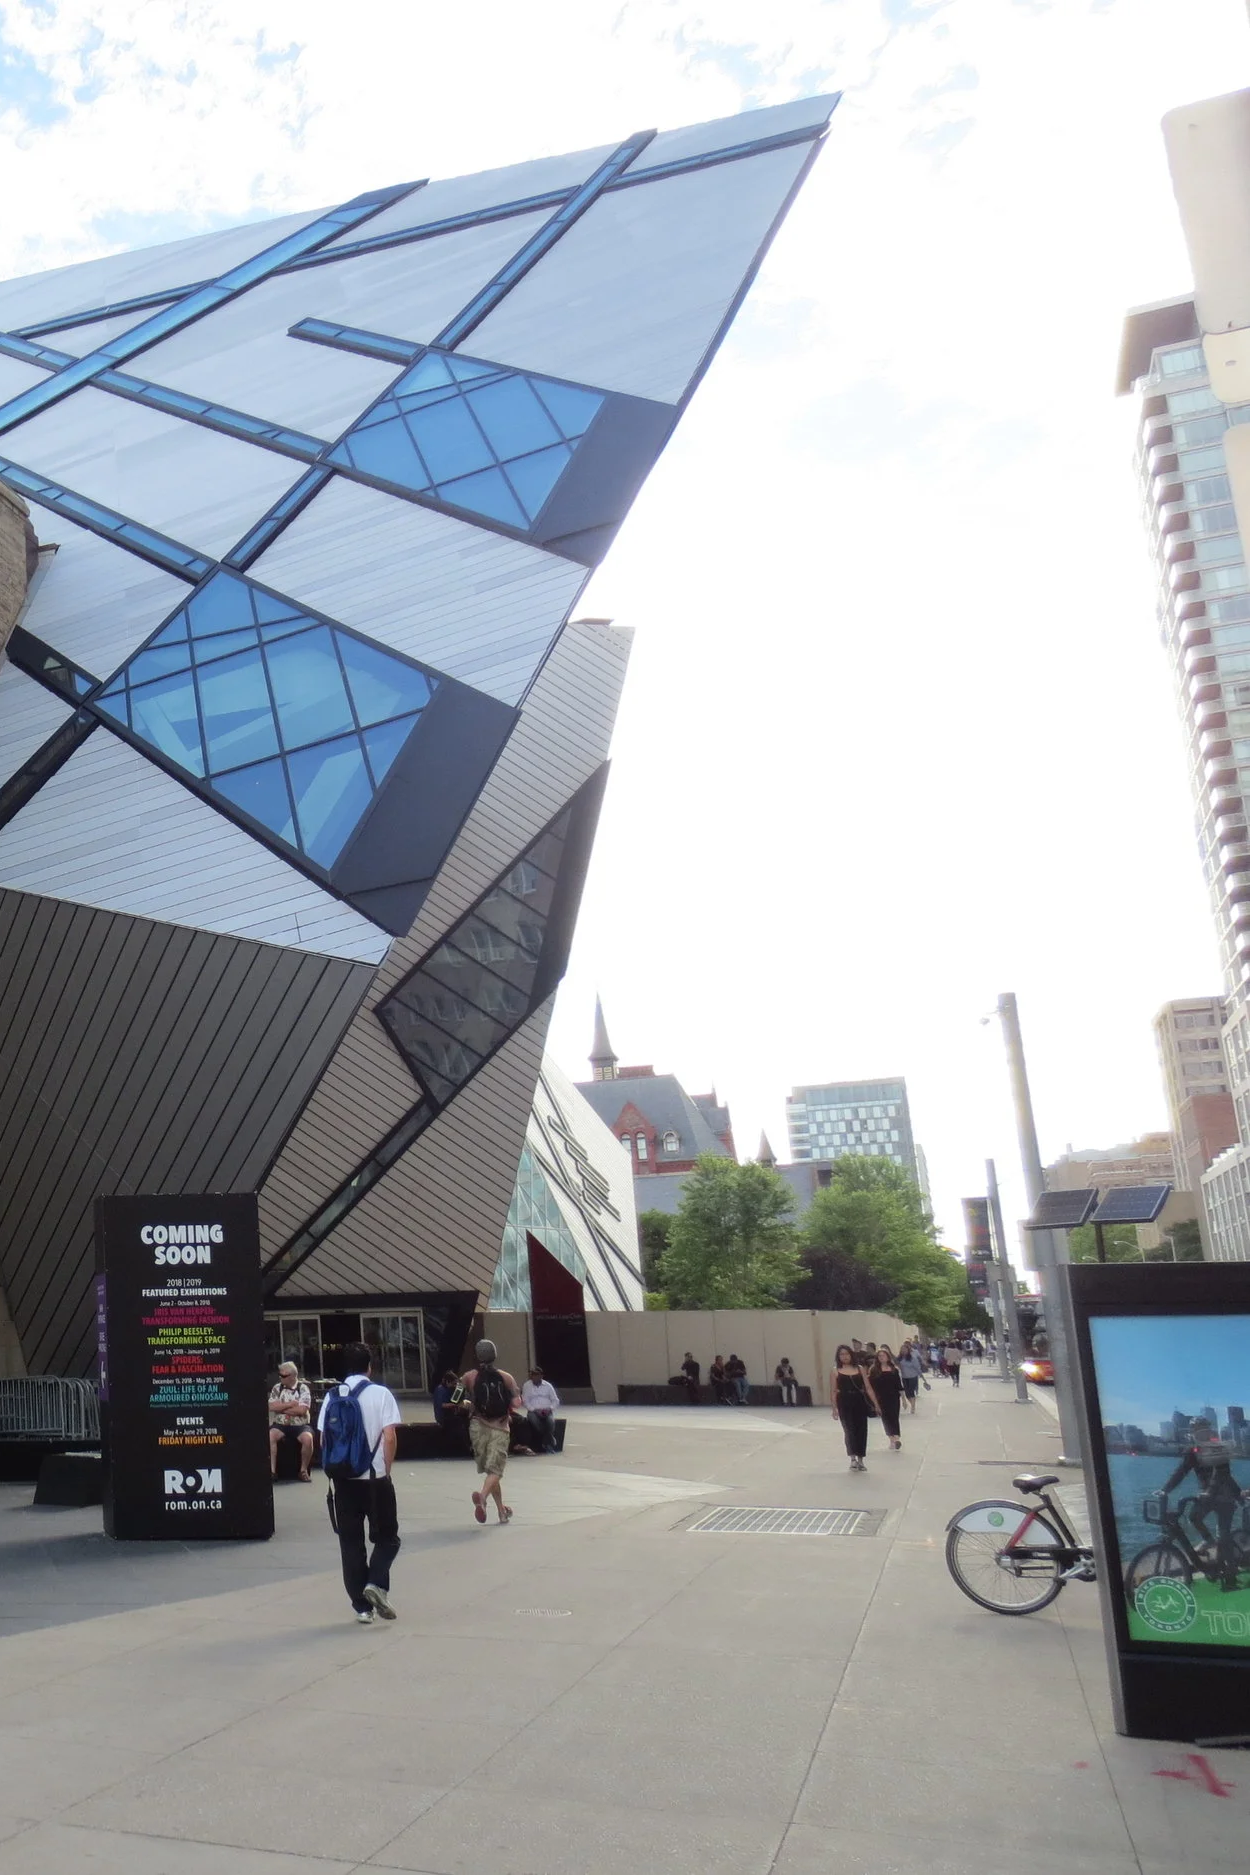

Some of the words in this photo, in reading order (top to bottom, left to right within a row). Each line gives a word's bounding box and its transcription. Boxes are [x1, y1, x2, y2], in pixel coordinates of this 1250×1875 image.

[140, 1224, 224, 1245] COMING
[154, 1246, 211, 1265] SOON
[142, 1288, 179, 1297] FEATURED
[180, 1287, 228, 1296] EXHIBITIONS
[142, 1316, 198, 1325] TRANSFORMING
[199, 1315, 229, 1324] FASHION
[158, 1328, 182, 1336] PHILIP
[183, 1327, 214, 1335] BEESLEY:
[147, 1336, 203, 1345] TRANSFORMING
[204, 1336, 226, 1344] SPACE
[187, 1348, 204, 1356] January
[152, 1365, 169, 1374] FEAR
[177, 1364, 224, 1373] FASCINATION
[195, 1377, 205, 1385] May
[159, 1386, 180, 1394] ZUUL:
[181, 1385, 195, 1393] LIFE
[197, 1385, 207, 1393] OF
[150, 1394, 190, 1402] ARMOURED
[191, 1393, 228, 1401] DINOSAUR
[176, 1417, 204, 1425] EVENTS
[163, 1429, 174, 1437] May
[158, 1437, 184, 1445] FRIDAY
[184, 1436, 207, 1444] NIGHT
[207, 1436, 223, 1444] LIVE
[164, 1469, 223, 1494] ROM
[165, 1499, 222, 1511] rom.on.ca
[1138, 1580, 1155, 1599] BIKE
[1160, 1579, 1191, 1601] SHARE
[1144, 1613, 1192, 1631] TORONTO
[1201, 1610, 1250, 1637] TO
